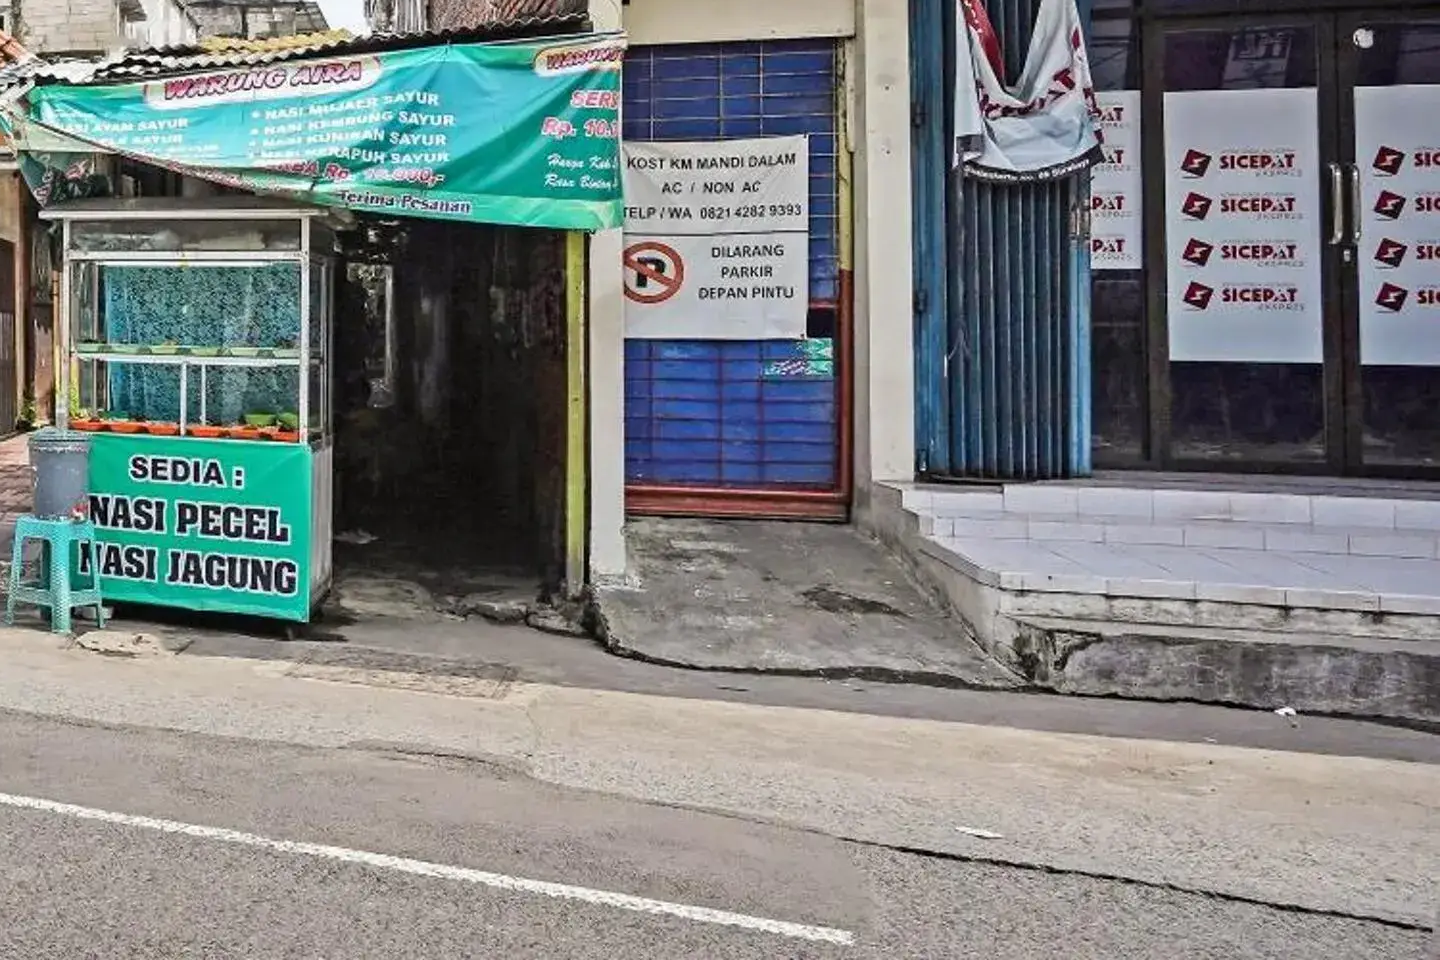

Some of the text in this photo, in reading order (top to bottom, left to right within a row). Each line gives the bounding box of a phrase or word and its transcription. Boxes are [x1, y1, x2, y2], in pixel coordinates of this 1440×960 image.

[164, 59, 362, 100] WARUNG AIRA
[265, 109, 303, 120] NASI
[383, 91, 440, 107] SAYUR
[136, 117, 189, 131] SAYUR
[398, 110, 456, 127] SAYUR
[541, 116, 578, 138] Rp.
[389, 130, 447, 146] SAYUR
[390, 152, 450, 164] SAYUR
[627, 153, 796, 170] KOST KM MANDI DALAM
[1219, 153, 1295, 169] SICEPAT
[662, 181, 683, 194] AC
[702, 181, 735, 194] NON
[742, 180, 762, 193] AC
[401, 195, 471, 214] Pesanan
[623, 206, 656, 219] TELP
[667, 206, 693, 219] WA
[1220, 197, 1296, 213] SICEPAT
[711, 244, 784, 258] DILARANG
[1221, 244, 1297, 260] SICEPAT
[721, 265, 773, 279] PARKIR
[698, 285, 794, 300] DEPAN PINTU
[1222, 287, 1298, 303] SICEPAT
[129, 455, 225, 486] SEDIA
[87, 494, 290, 543] NASI PECEL
[167, 550, 297, 595] JAGUNG
